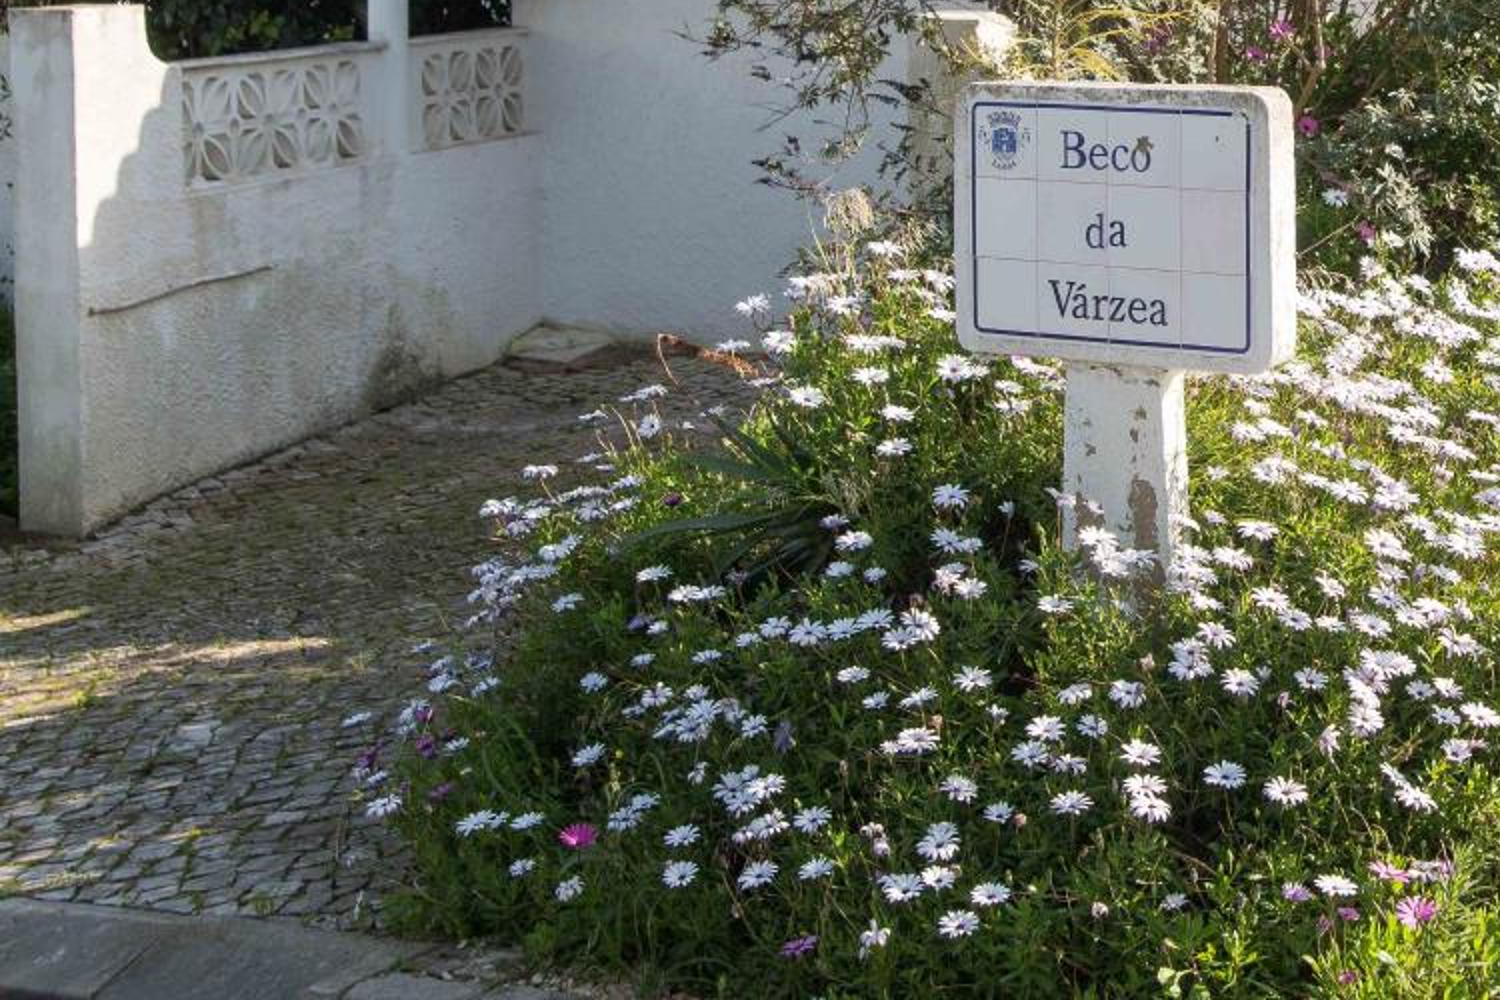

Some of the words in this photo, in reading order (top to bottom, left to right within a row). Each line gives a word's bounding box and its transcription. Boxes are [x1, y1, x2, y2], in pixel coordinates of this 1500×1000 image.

[1060, 130, 1151, 173] Beco
[1085, 213, 1126, 248] da
[1048, 279, 1168, 327] Várzea
